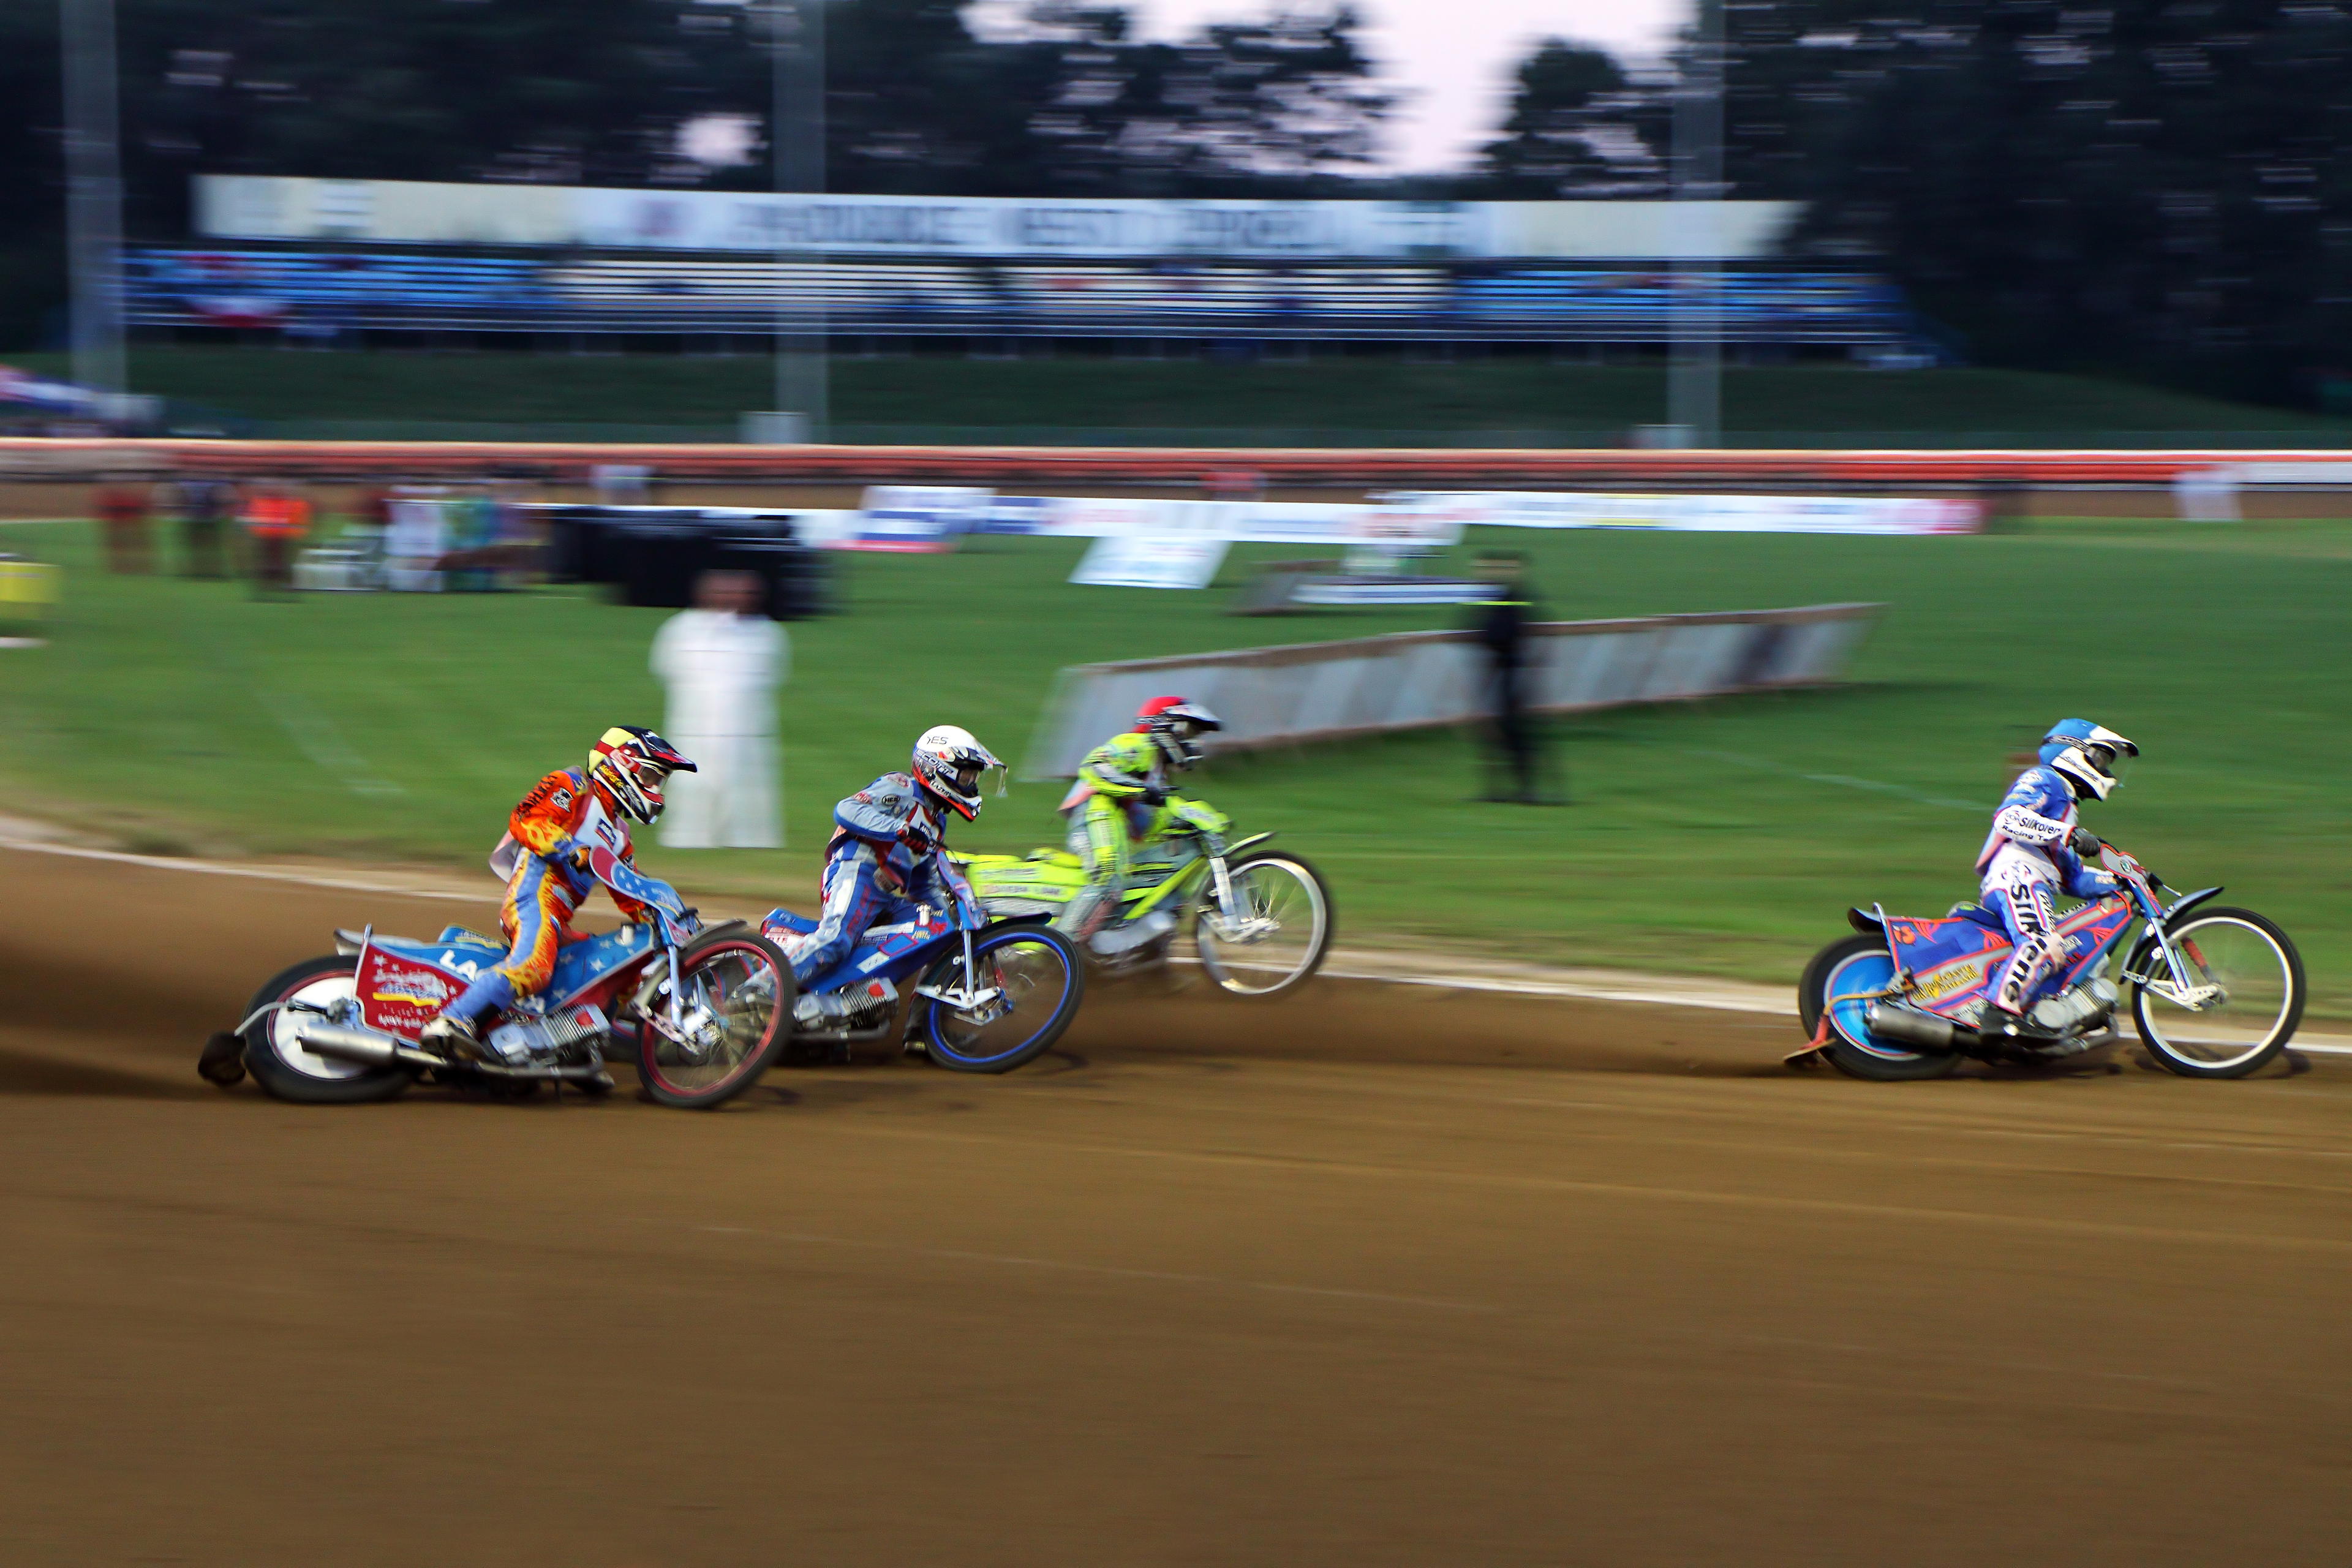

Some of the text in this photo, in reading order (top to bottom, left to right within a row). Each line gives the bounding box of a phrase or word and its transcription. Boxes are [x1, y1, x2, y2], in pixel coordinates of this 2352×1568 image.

[926, 736, 949, 745] YES
[2002, 824, 2034, 840] Racing
[2003, 883, 2051, 1003] Silklene
